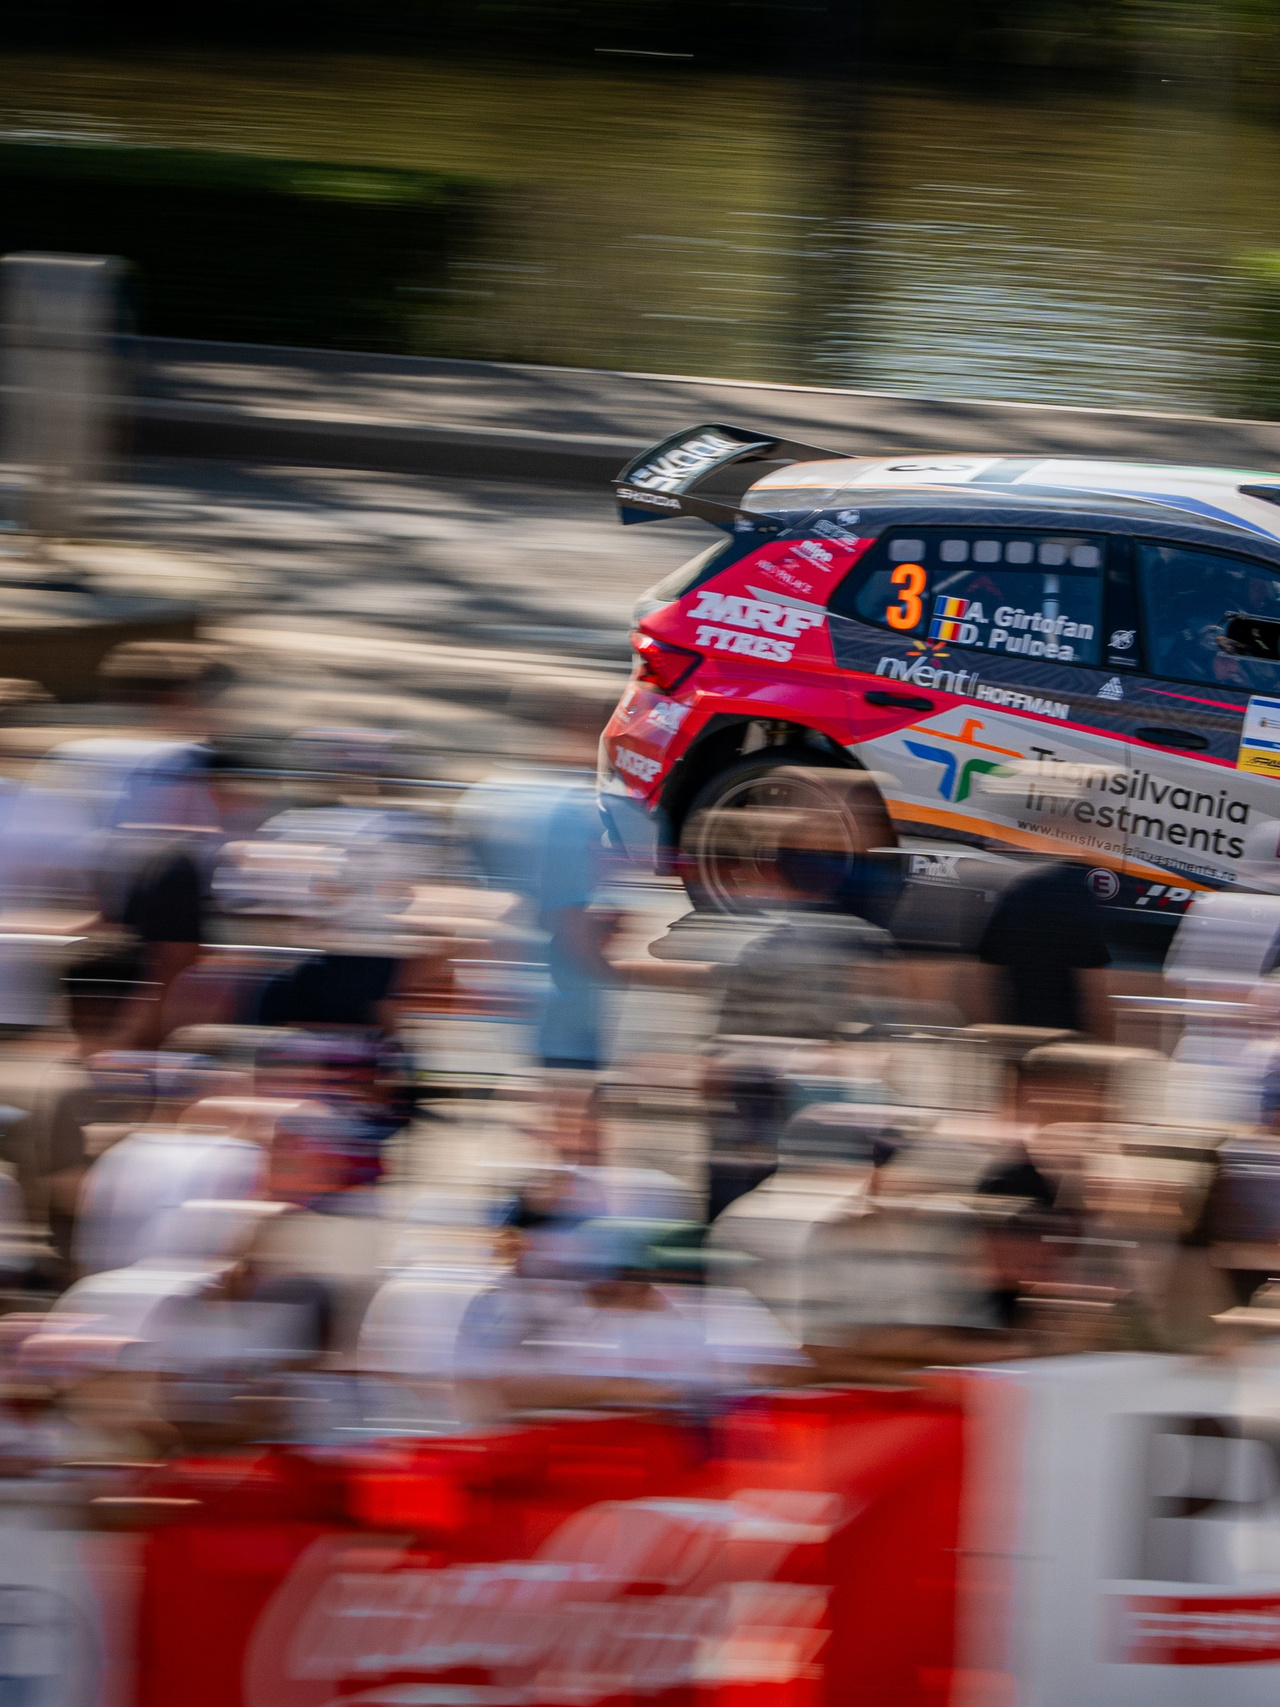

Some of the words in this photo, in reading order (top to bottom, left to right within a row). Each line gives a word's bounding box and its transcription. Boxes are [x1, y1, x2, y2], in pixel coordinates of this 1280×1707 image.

[686, 590, 826, 638] MRF
[886, 563, 927, 630] 3
[963, 601, 989, 624] A.
[695, 625, 796, 664] TYRES
[959, 622, 985, 647] D.
[975, 684, 1070, 720] HOFFMAN
[1025, 782, 1246, 860] Investments
